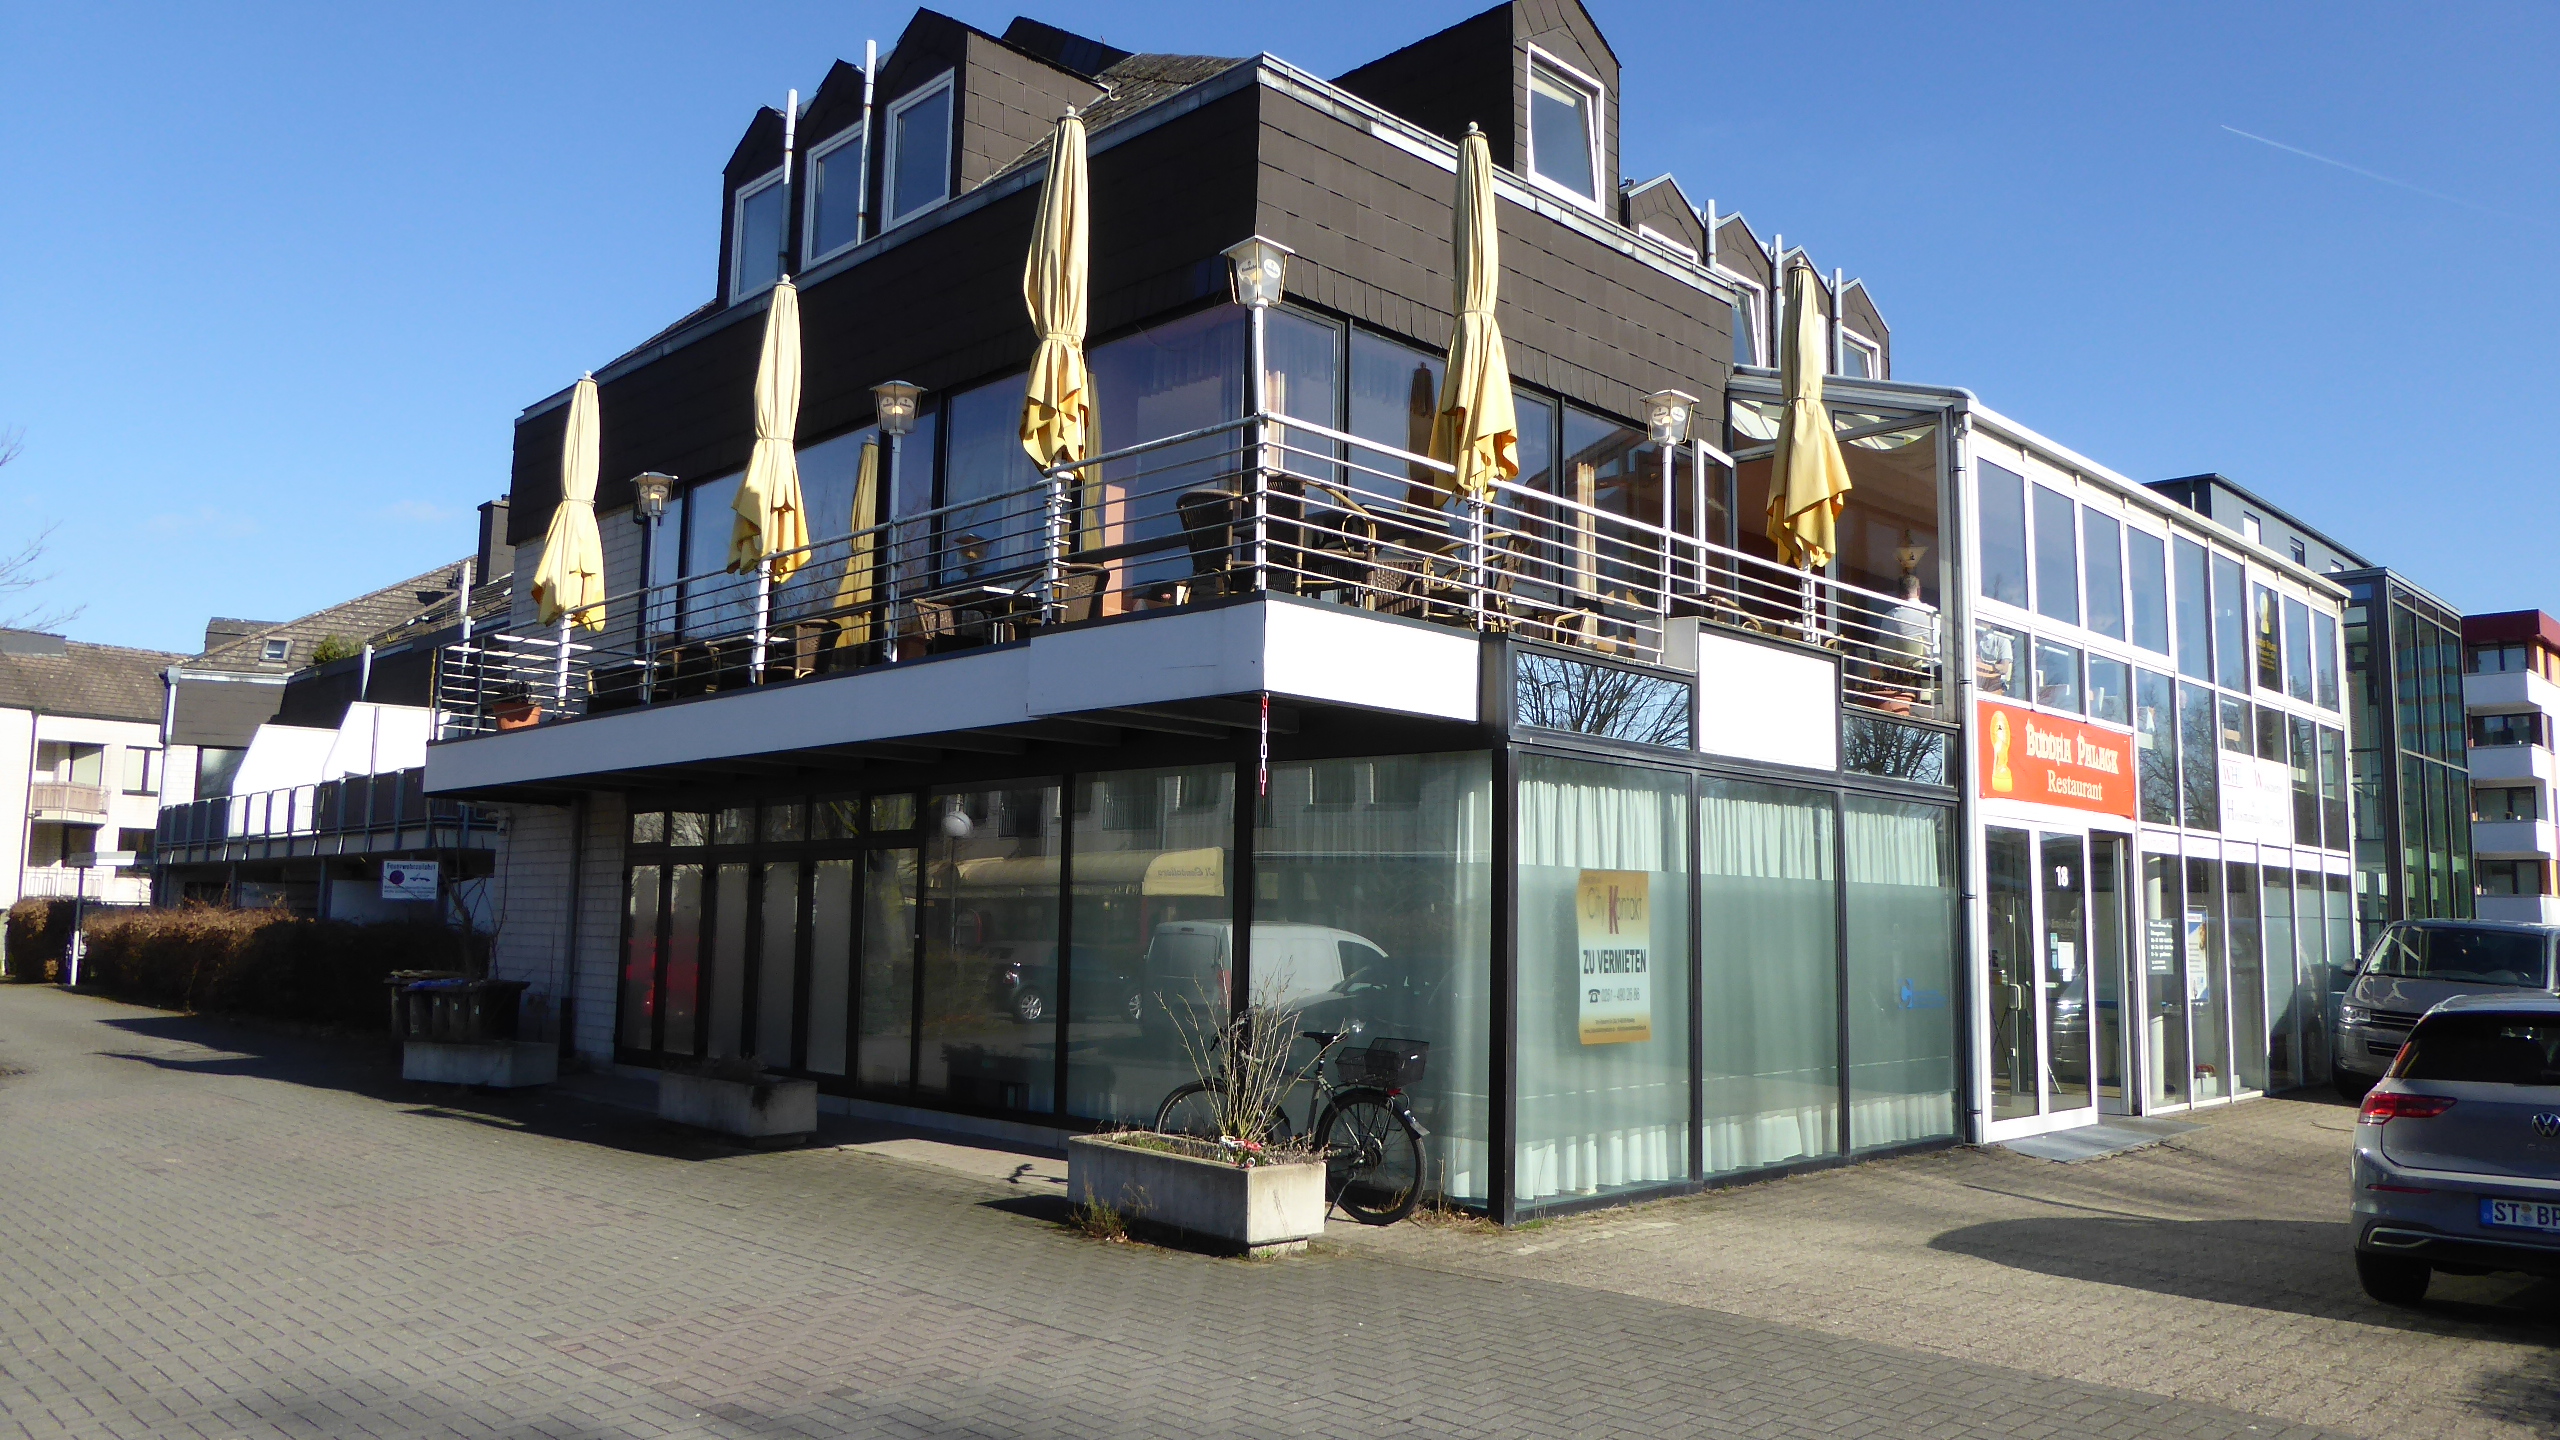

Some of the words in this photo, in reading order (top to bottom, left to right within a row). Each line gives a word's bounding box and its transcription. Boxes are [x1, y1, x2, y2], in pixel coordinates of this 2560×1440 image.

[2025, 718, 2073, 766] BUDDHA
[2047, 769, 2103, 801] Restaurant
[2055, 865, 2069, 887] 18
[1582, 949, 1595, 975] ZU
[1597, 949, 1647, 974] VERMIETEN
[2494, 1202, 2520, 1223] ST
